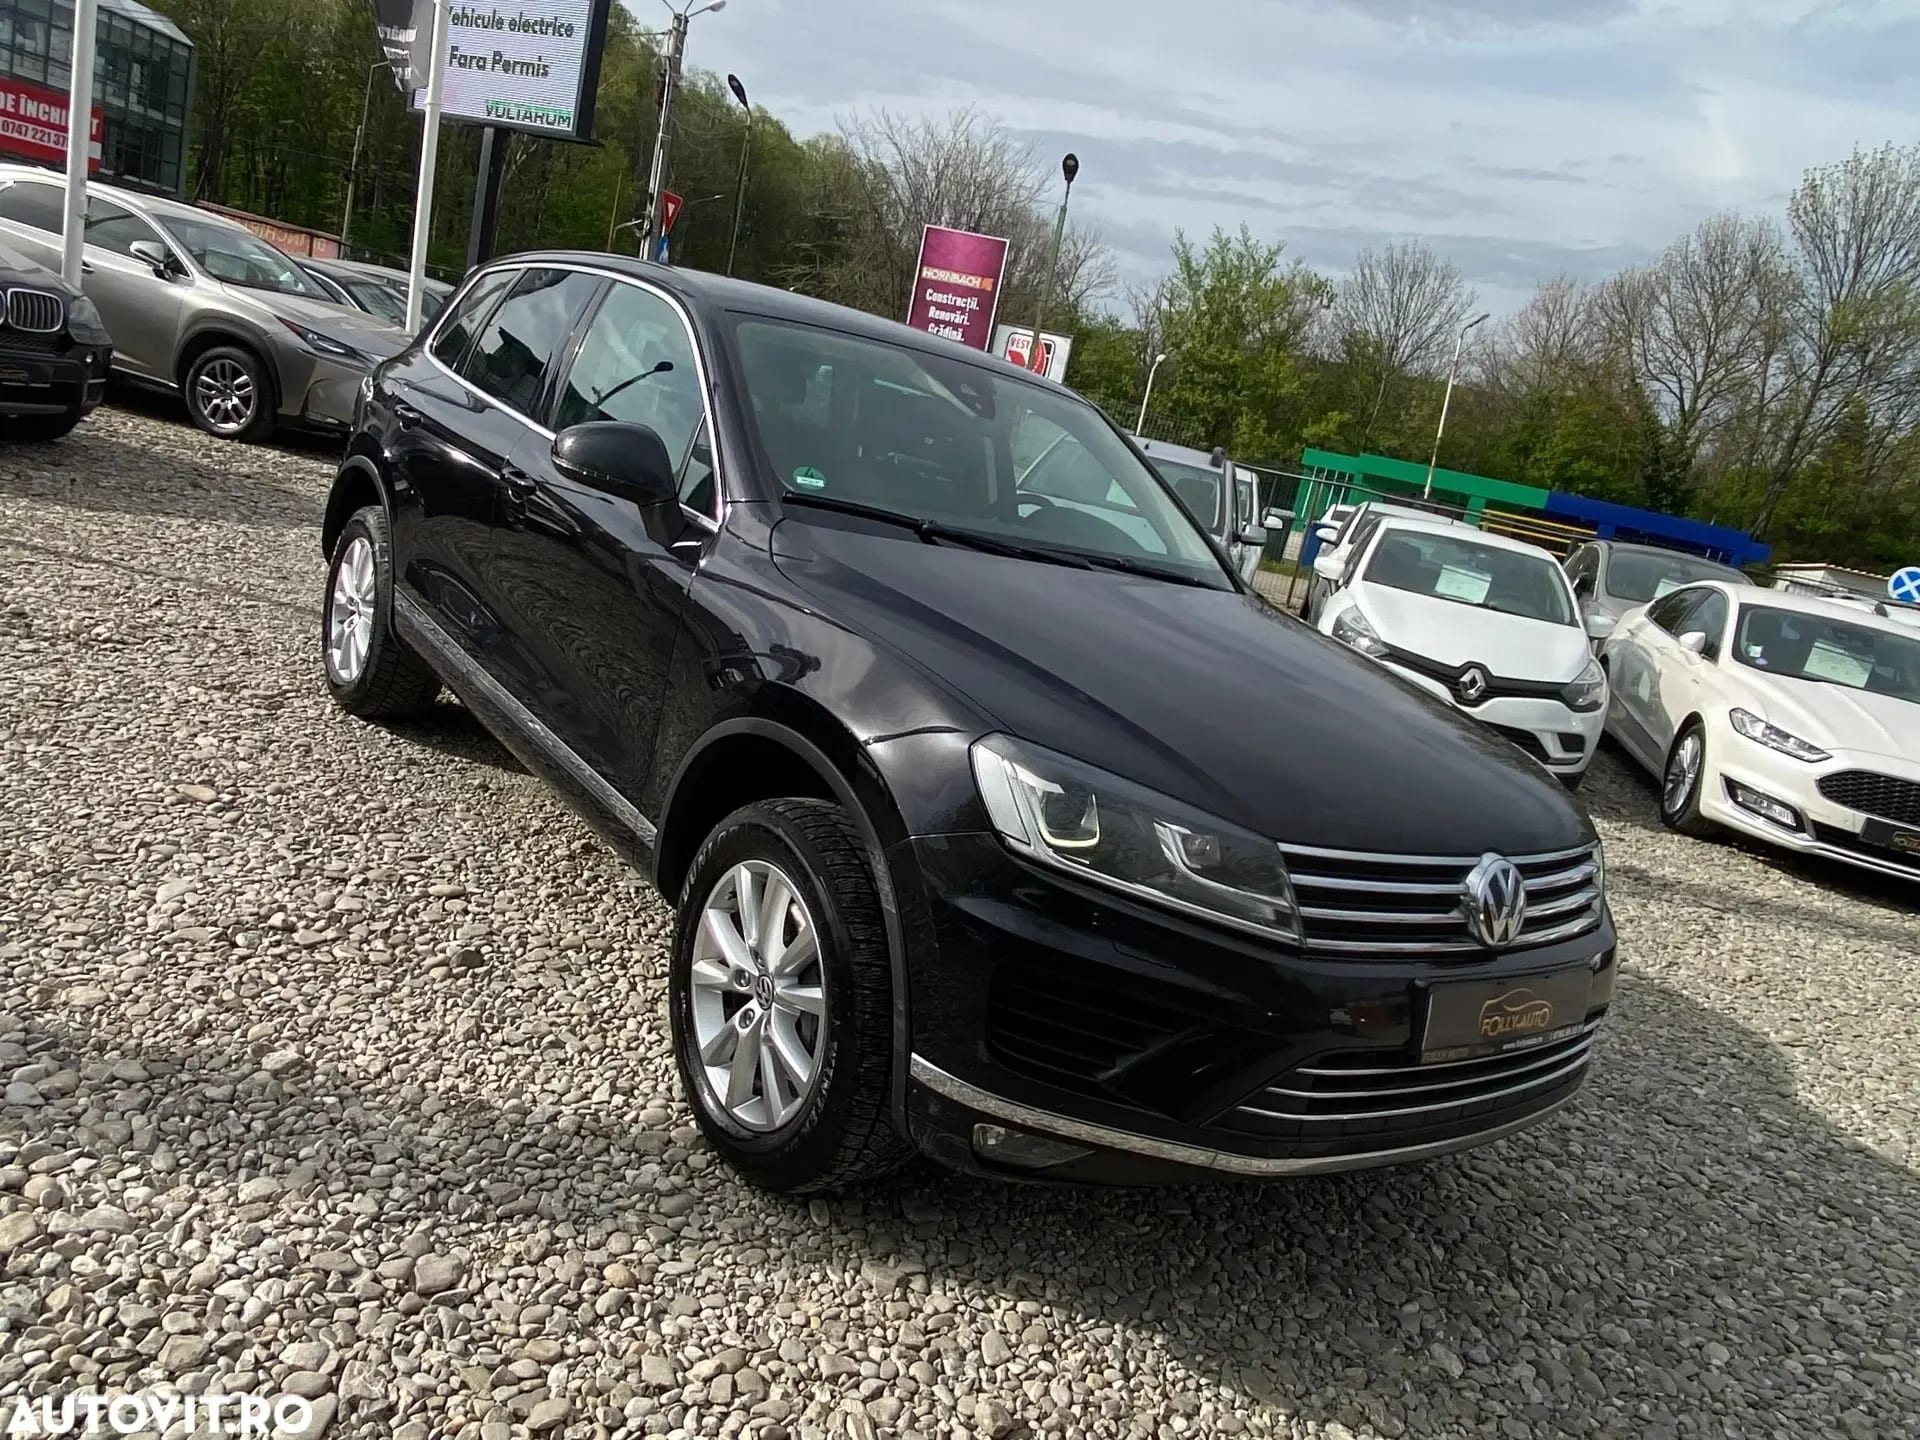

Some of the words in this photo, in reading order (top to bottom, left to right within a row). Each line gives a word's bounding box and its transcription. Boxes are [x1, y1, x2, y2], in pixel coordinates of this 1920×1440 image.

[509, 11, 574, 38] electrice
[449, 46, 486, 71] Fara
[492, 51, 549, 77] Permis
[20, 93, 99, 135] ÎNCHIT
[2, 120, 30, 138] 0747
[32, 128, 51, 143] 221
[53, 134, 68, 149] 37
[921, 266, 981, 289] HORNBACH
[928, 305, 971, 326] Renovări.
